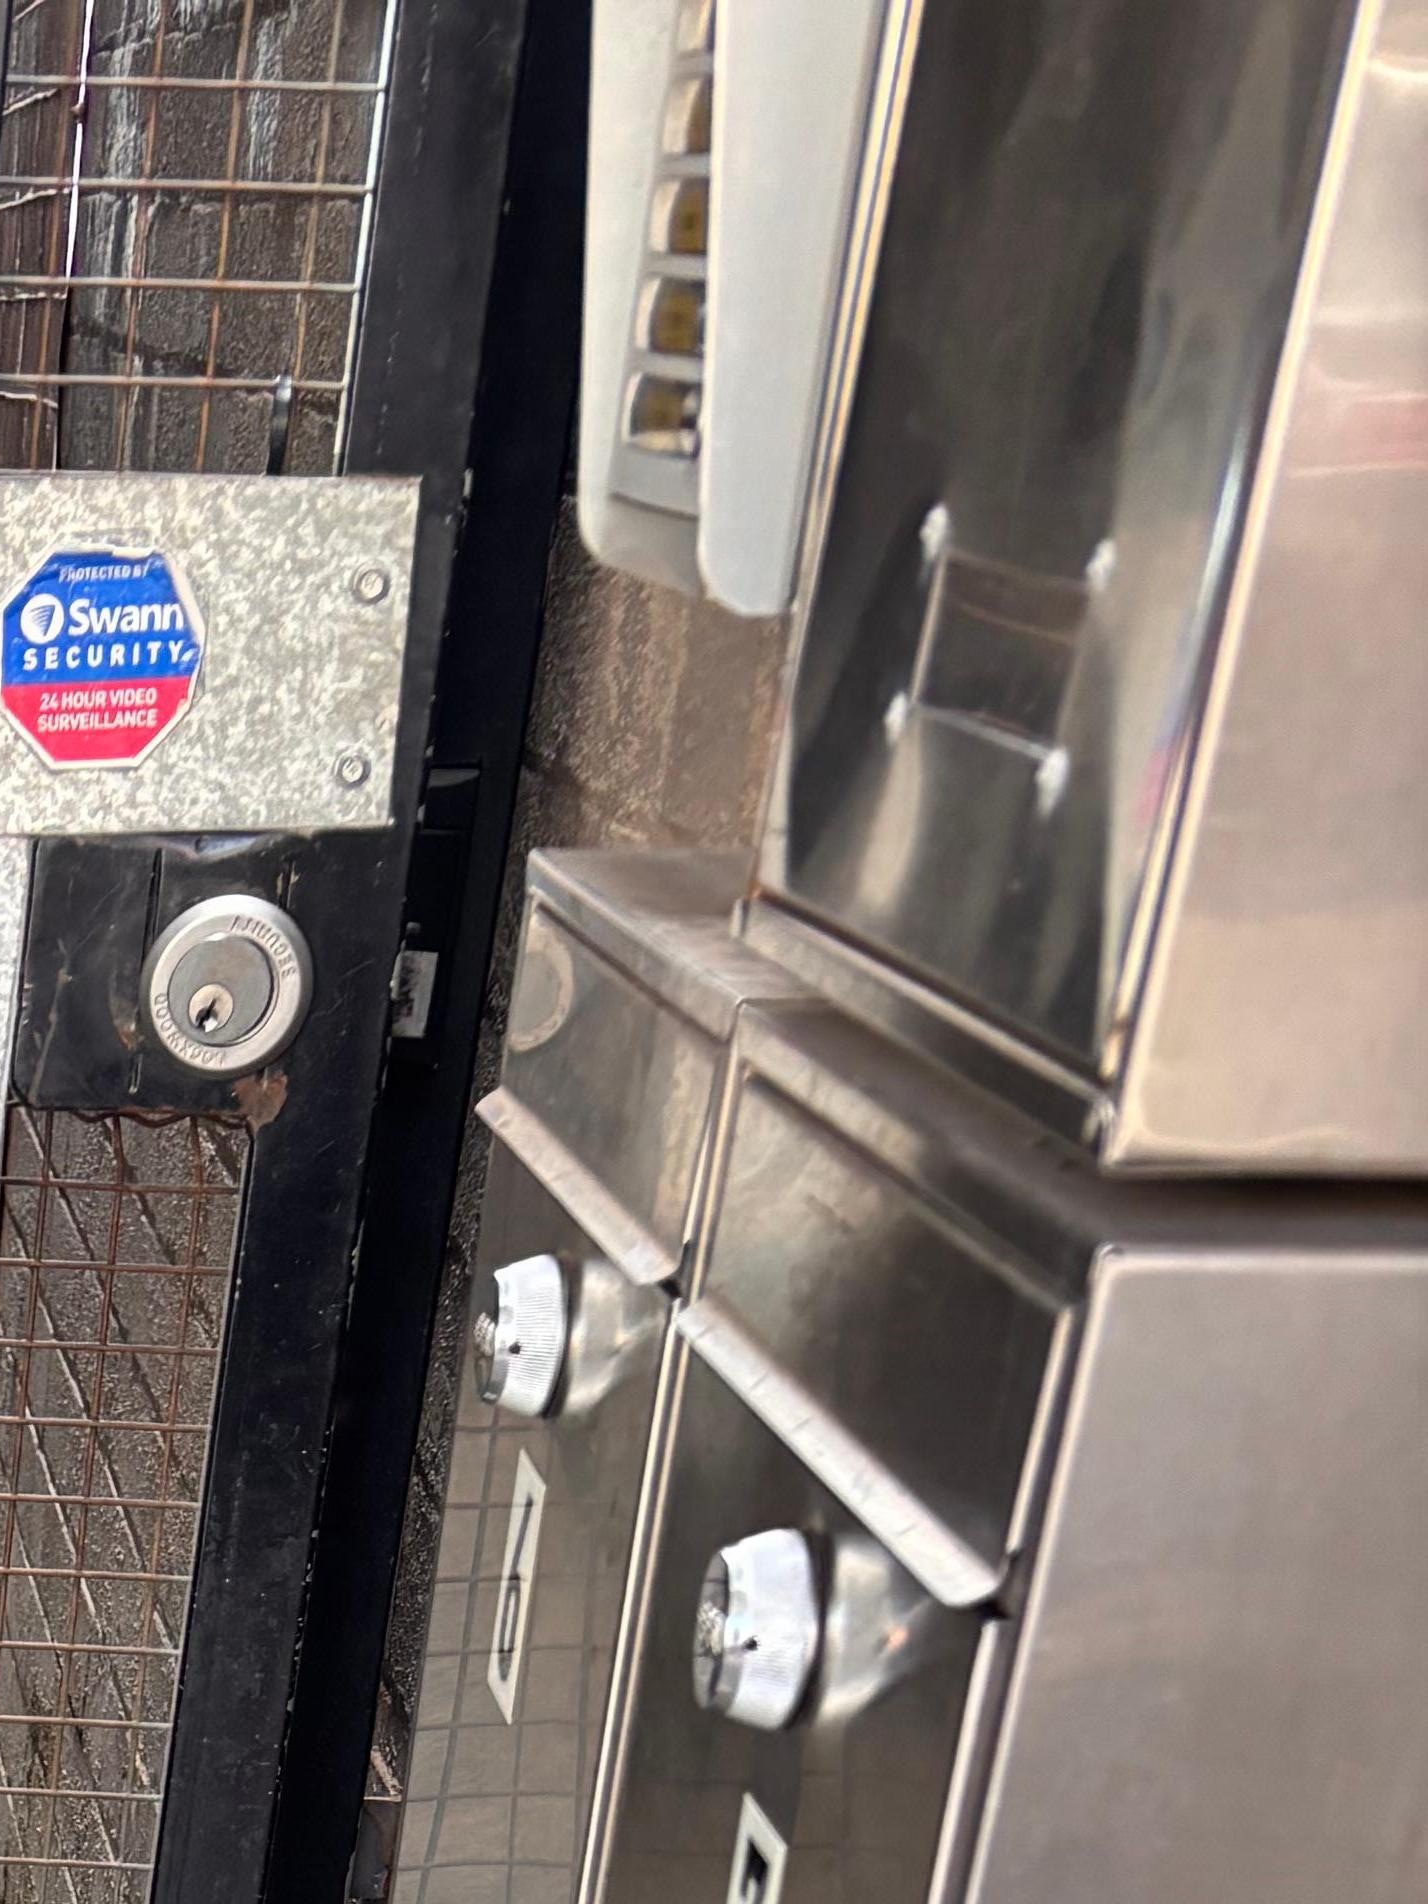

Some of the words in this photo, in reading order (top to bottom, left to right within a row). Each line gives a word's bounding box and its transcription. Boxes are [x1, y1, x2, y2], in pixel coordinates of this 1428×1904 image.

[58, 564, 131, 584] PROTECTED
[67, 598, 184, 637] Swann
[22, 640, 184, 672] SECURITY
[39, 692, 59, 711] 24
[61, 690, 107, 710] HOUR
[109, 687, 158, 708] VIDEO
[37, 708, 158, 733] SURVEILLANCE
